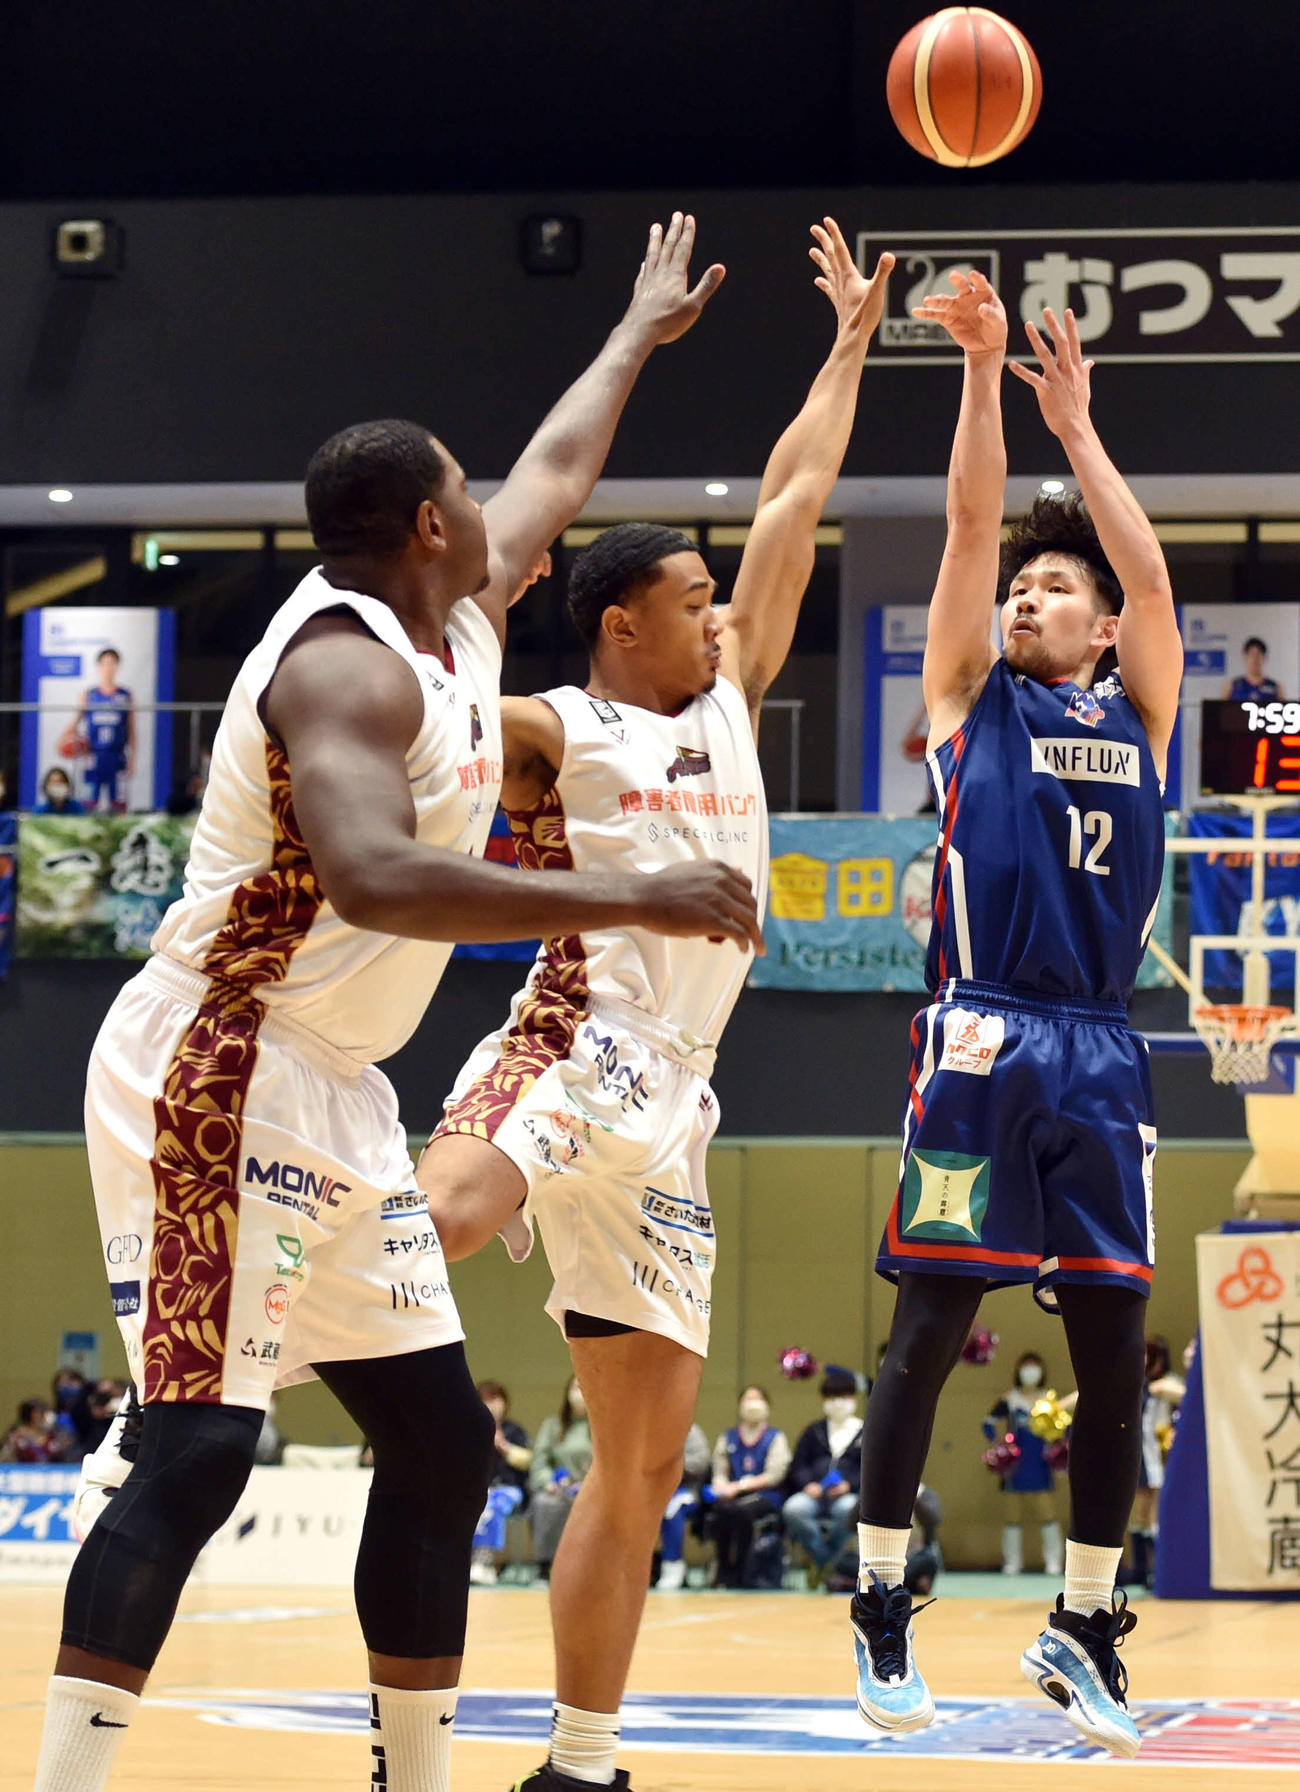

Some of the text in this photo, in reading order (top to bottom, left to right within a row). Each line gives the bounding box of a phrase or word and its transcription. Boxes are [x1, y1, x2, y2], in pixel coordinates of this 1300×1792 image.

[1019, 252, 1300, 344] むつマ
[1241, 702, 1300, 734] 7:59
[1066, 805, 1112, 876] 12
[245, 1156, 352, 1208] MONIC
[107, 1234, 142, 1265] GFD
[420, 1281, 449, 1299] CHA
